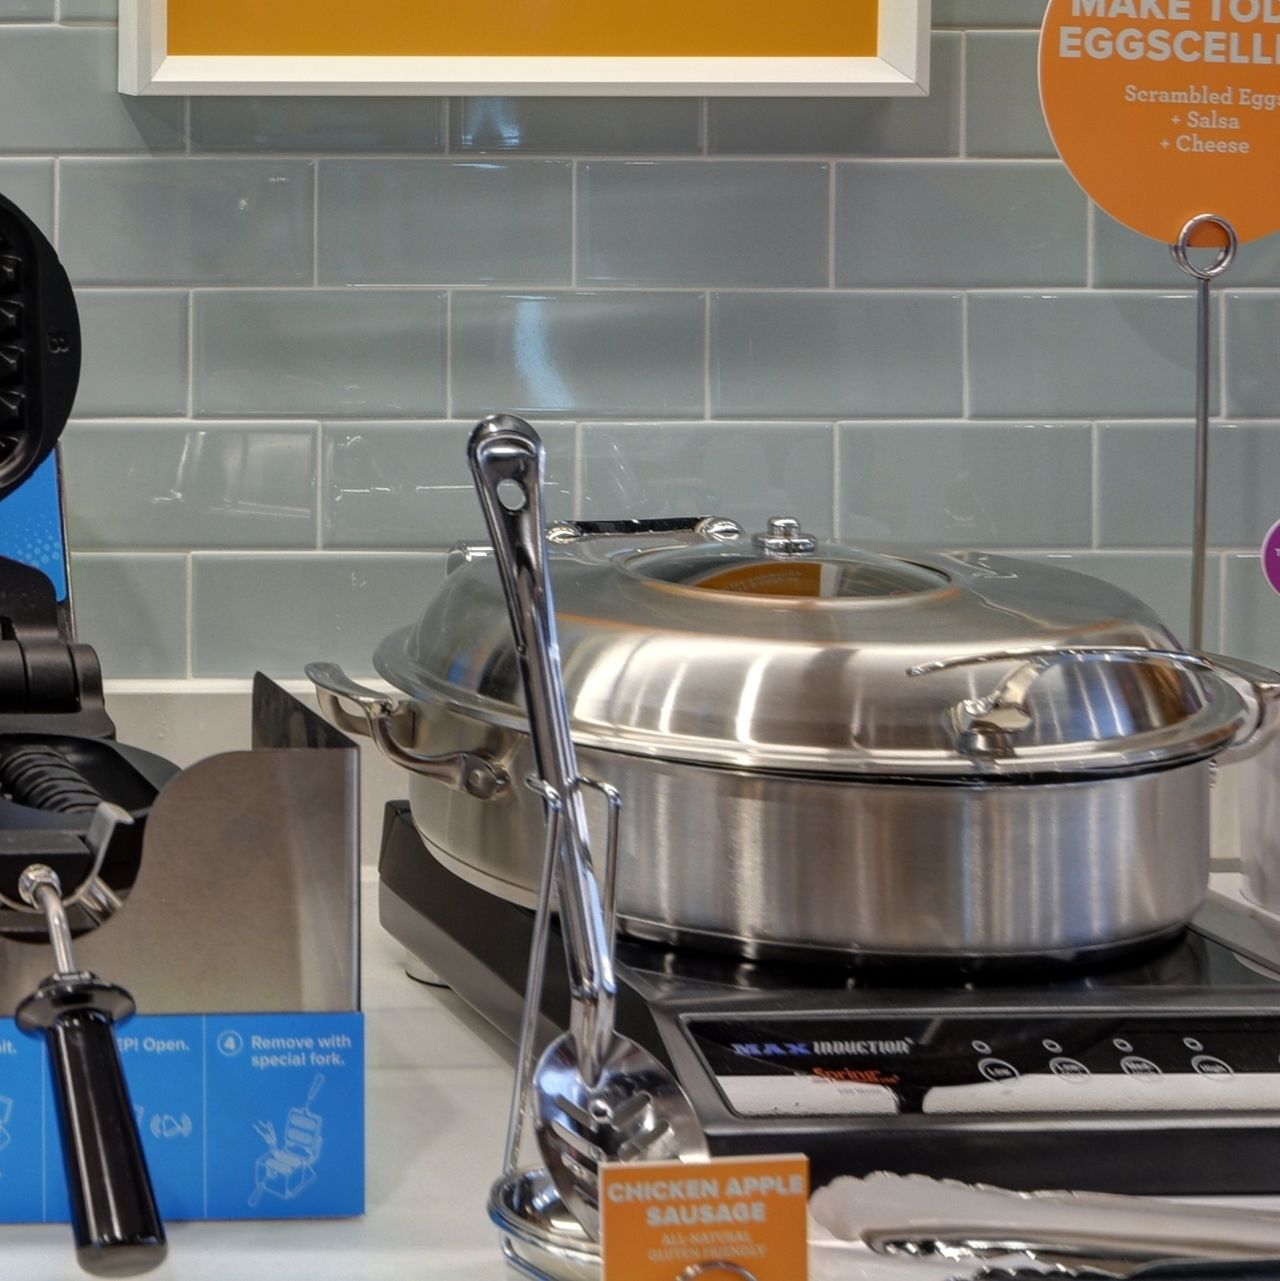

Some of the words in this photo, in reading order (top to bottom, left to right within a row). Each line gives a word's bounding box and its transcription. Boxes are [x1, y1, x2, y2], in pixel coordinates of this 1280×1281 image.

[1059, 26, 1280, 65] EGGSCELL
[1125, 84, 1233, 105] Scrambled
[1187, 111, 1240, 129] Salsa
[1176, 135, 1249, 154] Cheese
[143, 1038, 190, 1054] Open.
[252, 1036, 314, 1049] Remove
[318, 1034, 352, 1048] with
[731, 1043, 812, 1056] MAX
[252, 1053, 305, 1069] special
[311, 1052, 344, 1065] fork.
[608, 1178, 720, 1203] CHICKEN
[727, 1175, 804, 1197] APPLE
[647, 1203, 767, 1226] SAUSAGE
